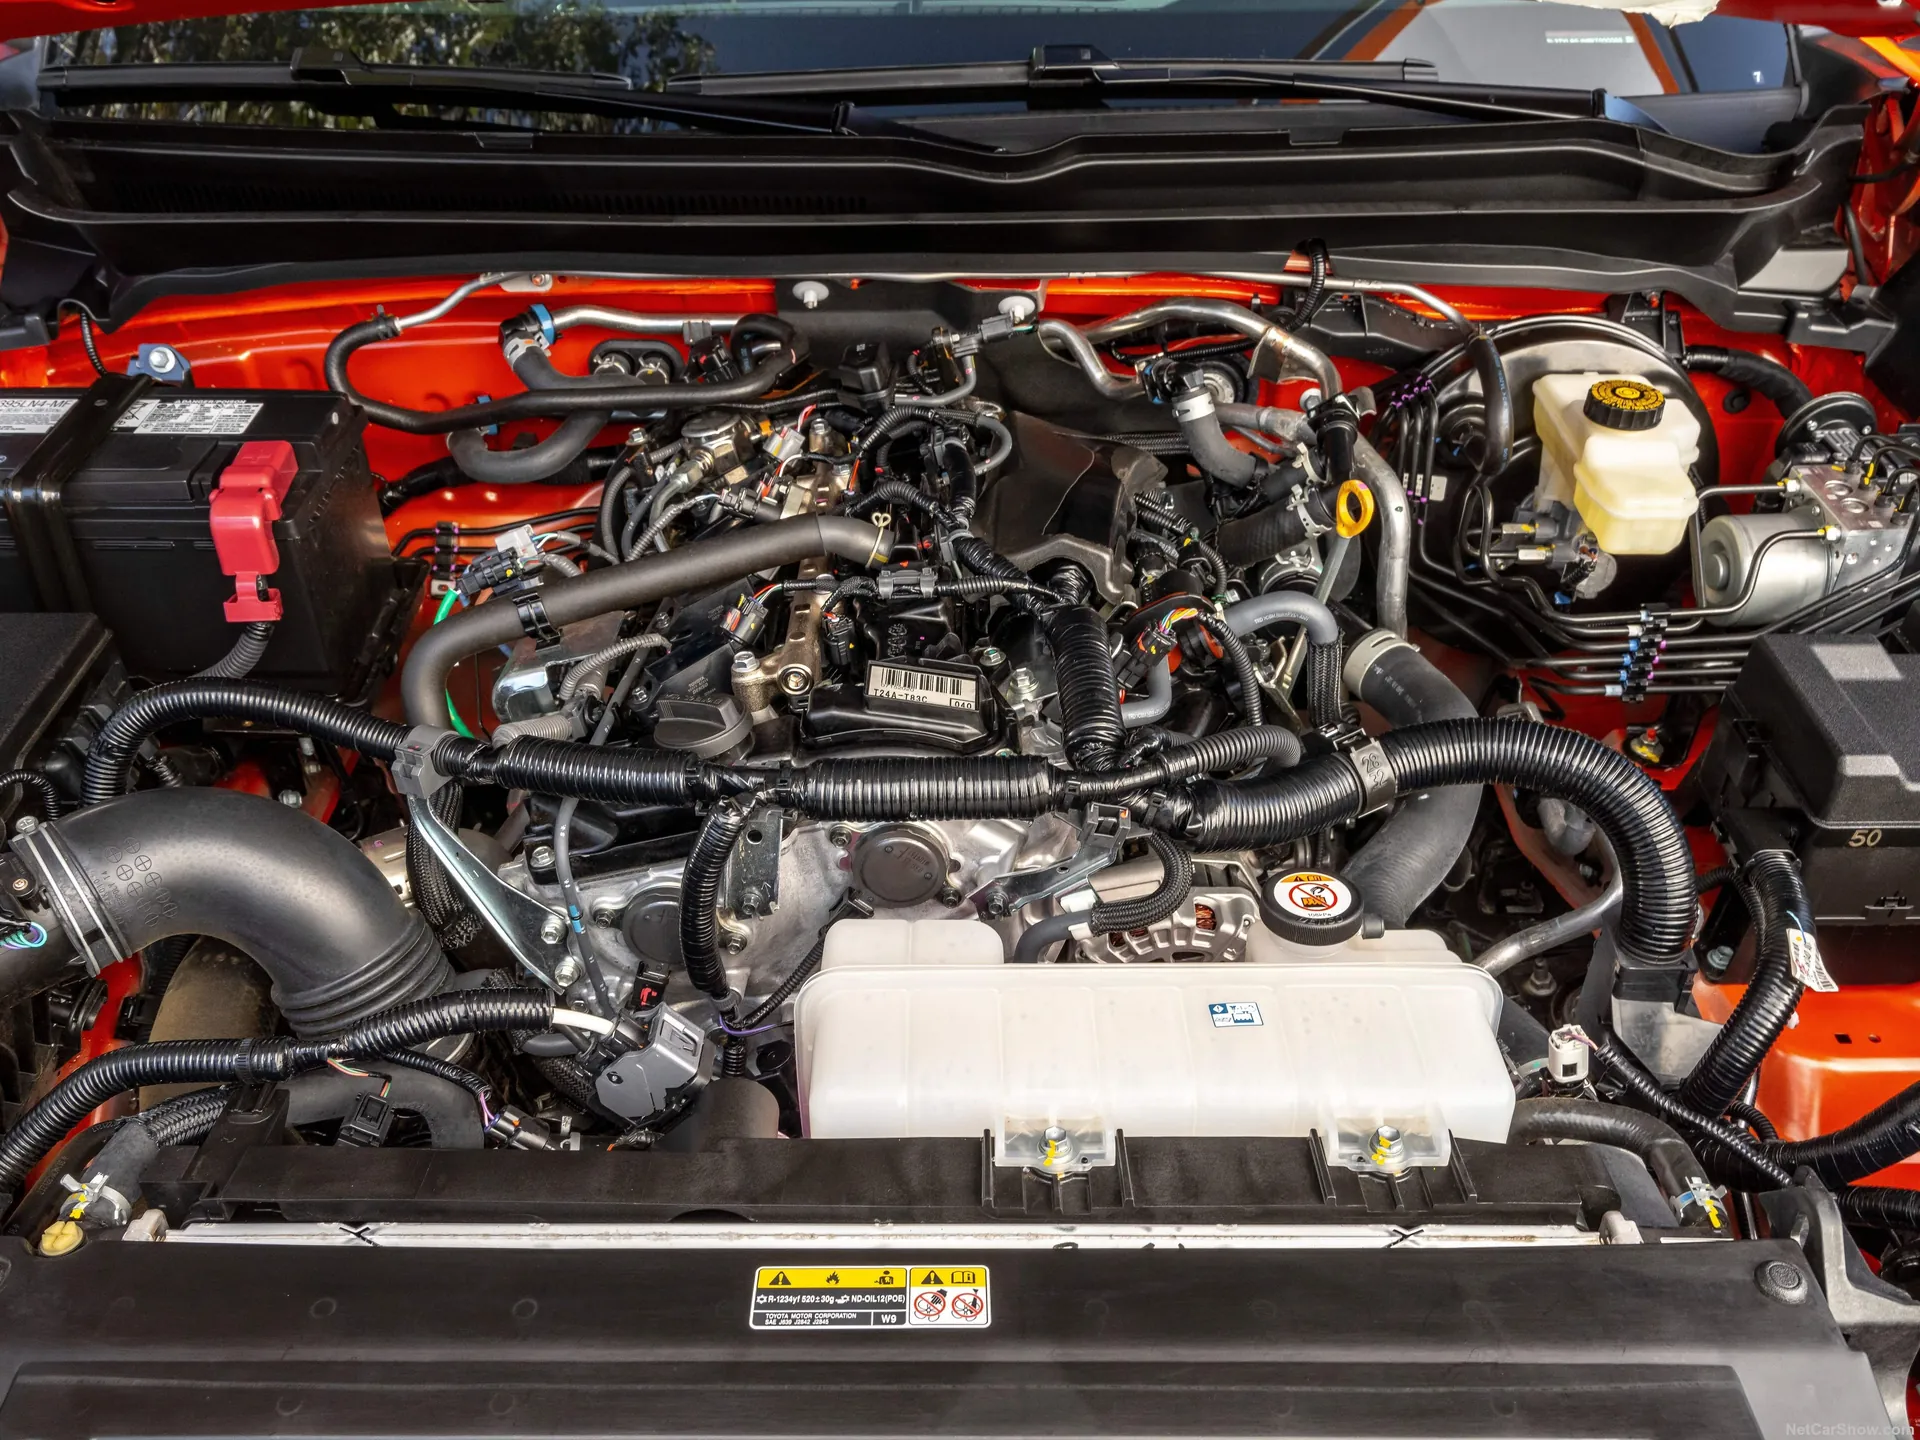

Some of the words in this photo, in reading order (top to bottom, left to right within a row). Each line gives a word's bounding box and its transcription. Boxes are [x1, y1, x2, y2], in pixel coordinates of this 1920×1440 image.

[1848, 829, 1882, 847] 50
[767, 1294, 801, 1304] R-1234yf
[801, 1294, 835, 1304] 520±30g
[851, 1294, 906, 1304] ND-OIL12(POE)
[881, 1315, 897, 1324] W9
